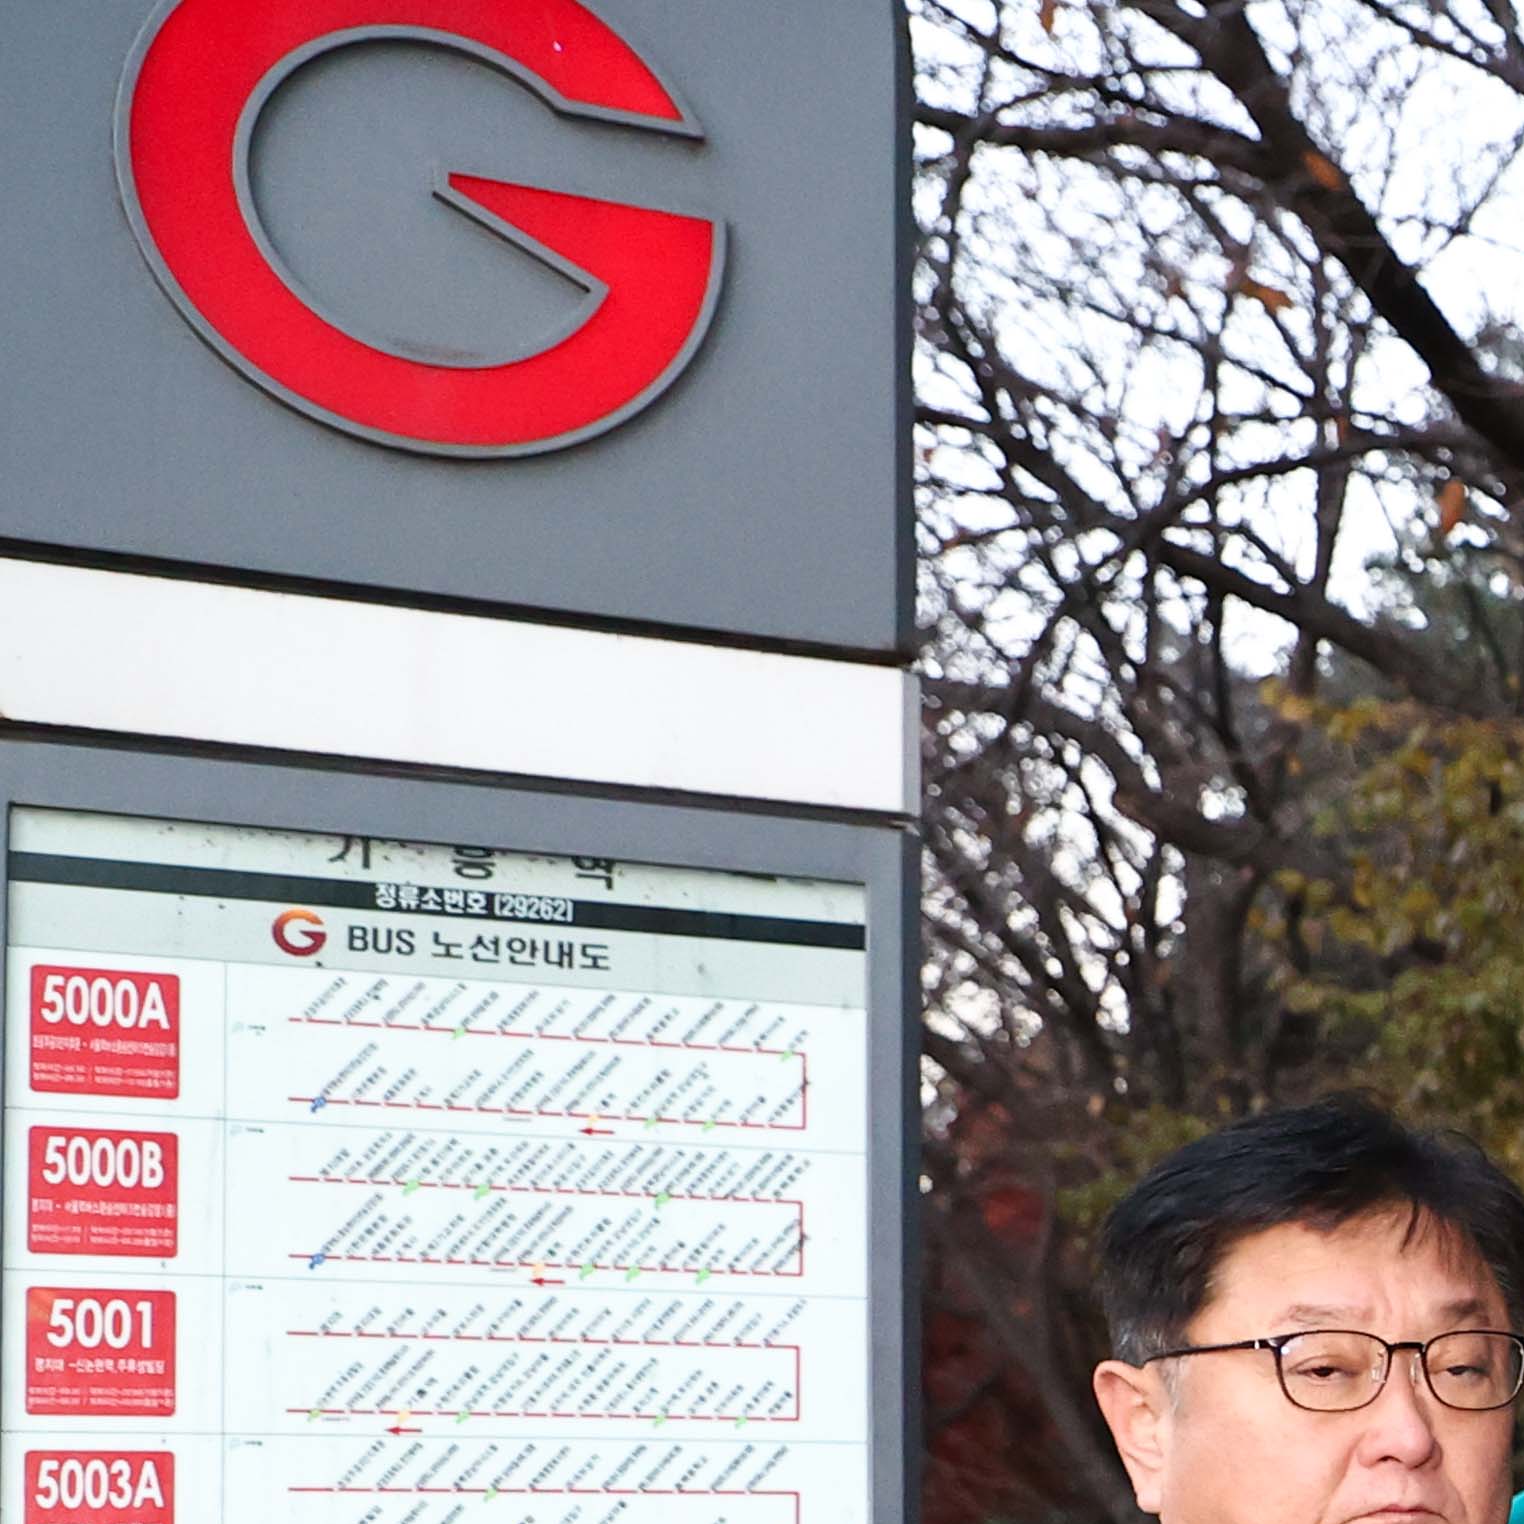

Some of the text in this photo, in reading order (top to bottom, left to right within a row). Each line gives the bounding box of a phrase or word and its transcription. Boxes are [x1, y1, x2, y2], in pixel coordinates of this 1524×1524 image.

[375, 882, 488, 915] 정류소번호
[348, 925, 416, 956] BUS
[431, 931, 612, 971] 노선안내도
[40, 974, 170, 1029] 5000A
[42, 1136, 164, 1188] 5000B
[47, 1298, 152, 1349] 5001
[35, 1459, 165, 1509] 5003A
